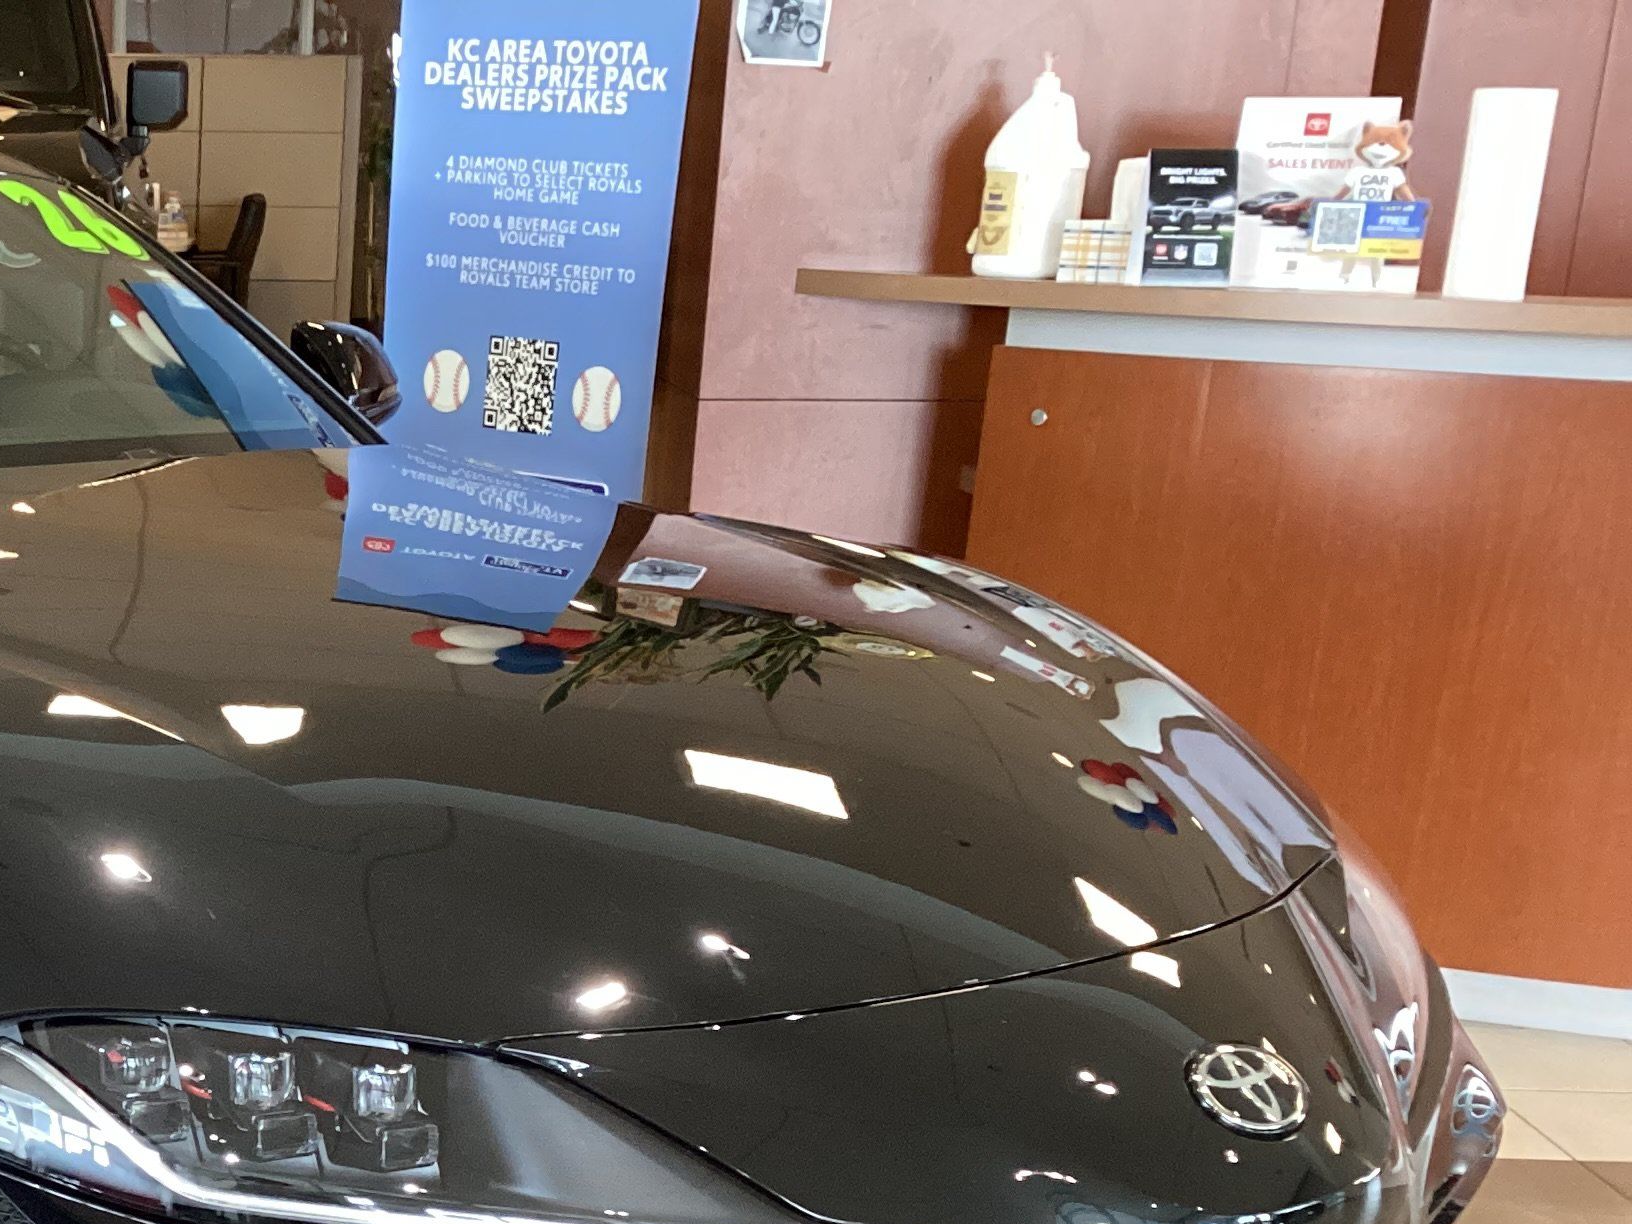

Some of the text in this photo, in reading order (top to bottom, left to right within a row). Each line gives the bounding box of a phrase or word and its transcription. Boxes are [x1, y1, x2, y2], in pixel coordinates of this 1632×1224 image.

[448, 38, 649, 65] KC AREA TOYOTA
[424, 62, 668, 92] DEALERS PRIZE PACK
[460, 86, 628, 115] SWEEPSTAKES
[446, 155, 628, 178] 4 DIAMOND CLUB TICKETS
[1268, 158, 1354, 169] SALES EVENT
[447, 170, 508, 186] PARKING
[512, 173, 530, 187] TO
[535, 174, 583, 190] SELECT
[588, 178, 642, 194] ROYALS
[1360, 175, 1389, 185] CAR
[493, 187, 579, 205] HOME GAME
[1359, 188, 1386, 200] FOX
[449, 212, 620, 237] FOOD & BEVERAGE CASH
[499, 230, 566, 249] VOUCHER
[425, 252, 635, 284] $100 MERCHANDISE CREDIT TO
[460, 270, 599, 295] ROYALS TEAM STORE
